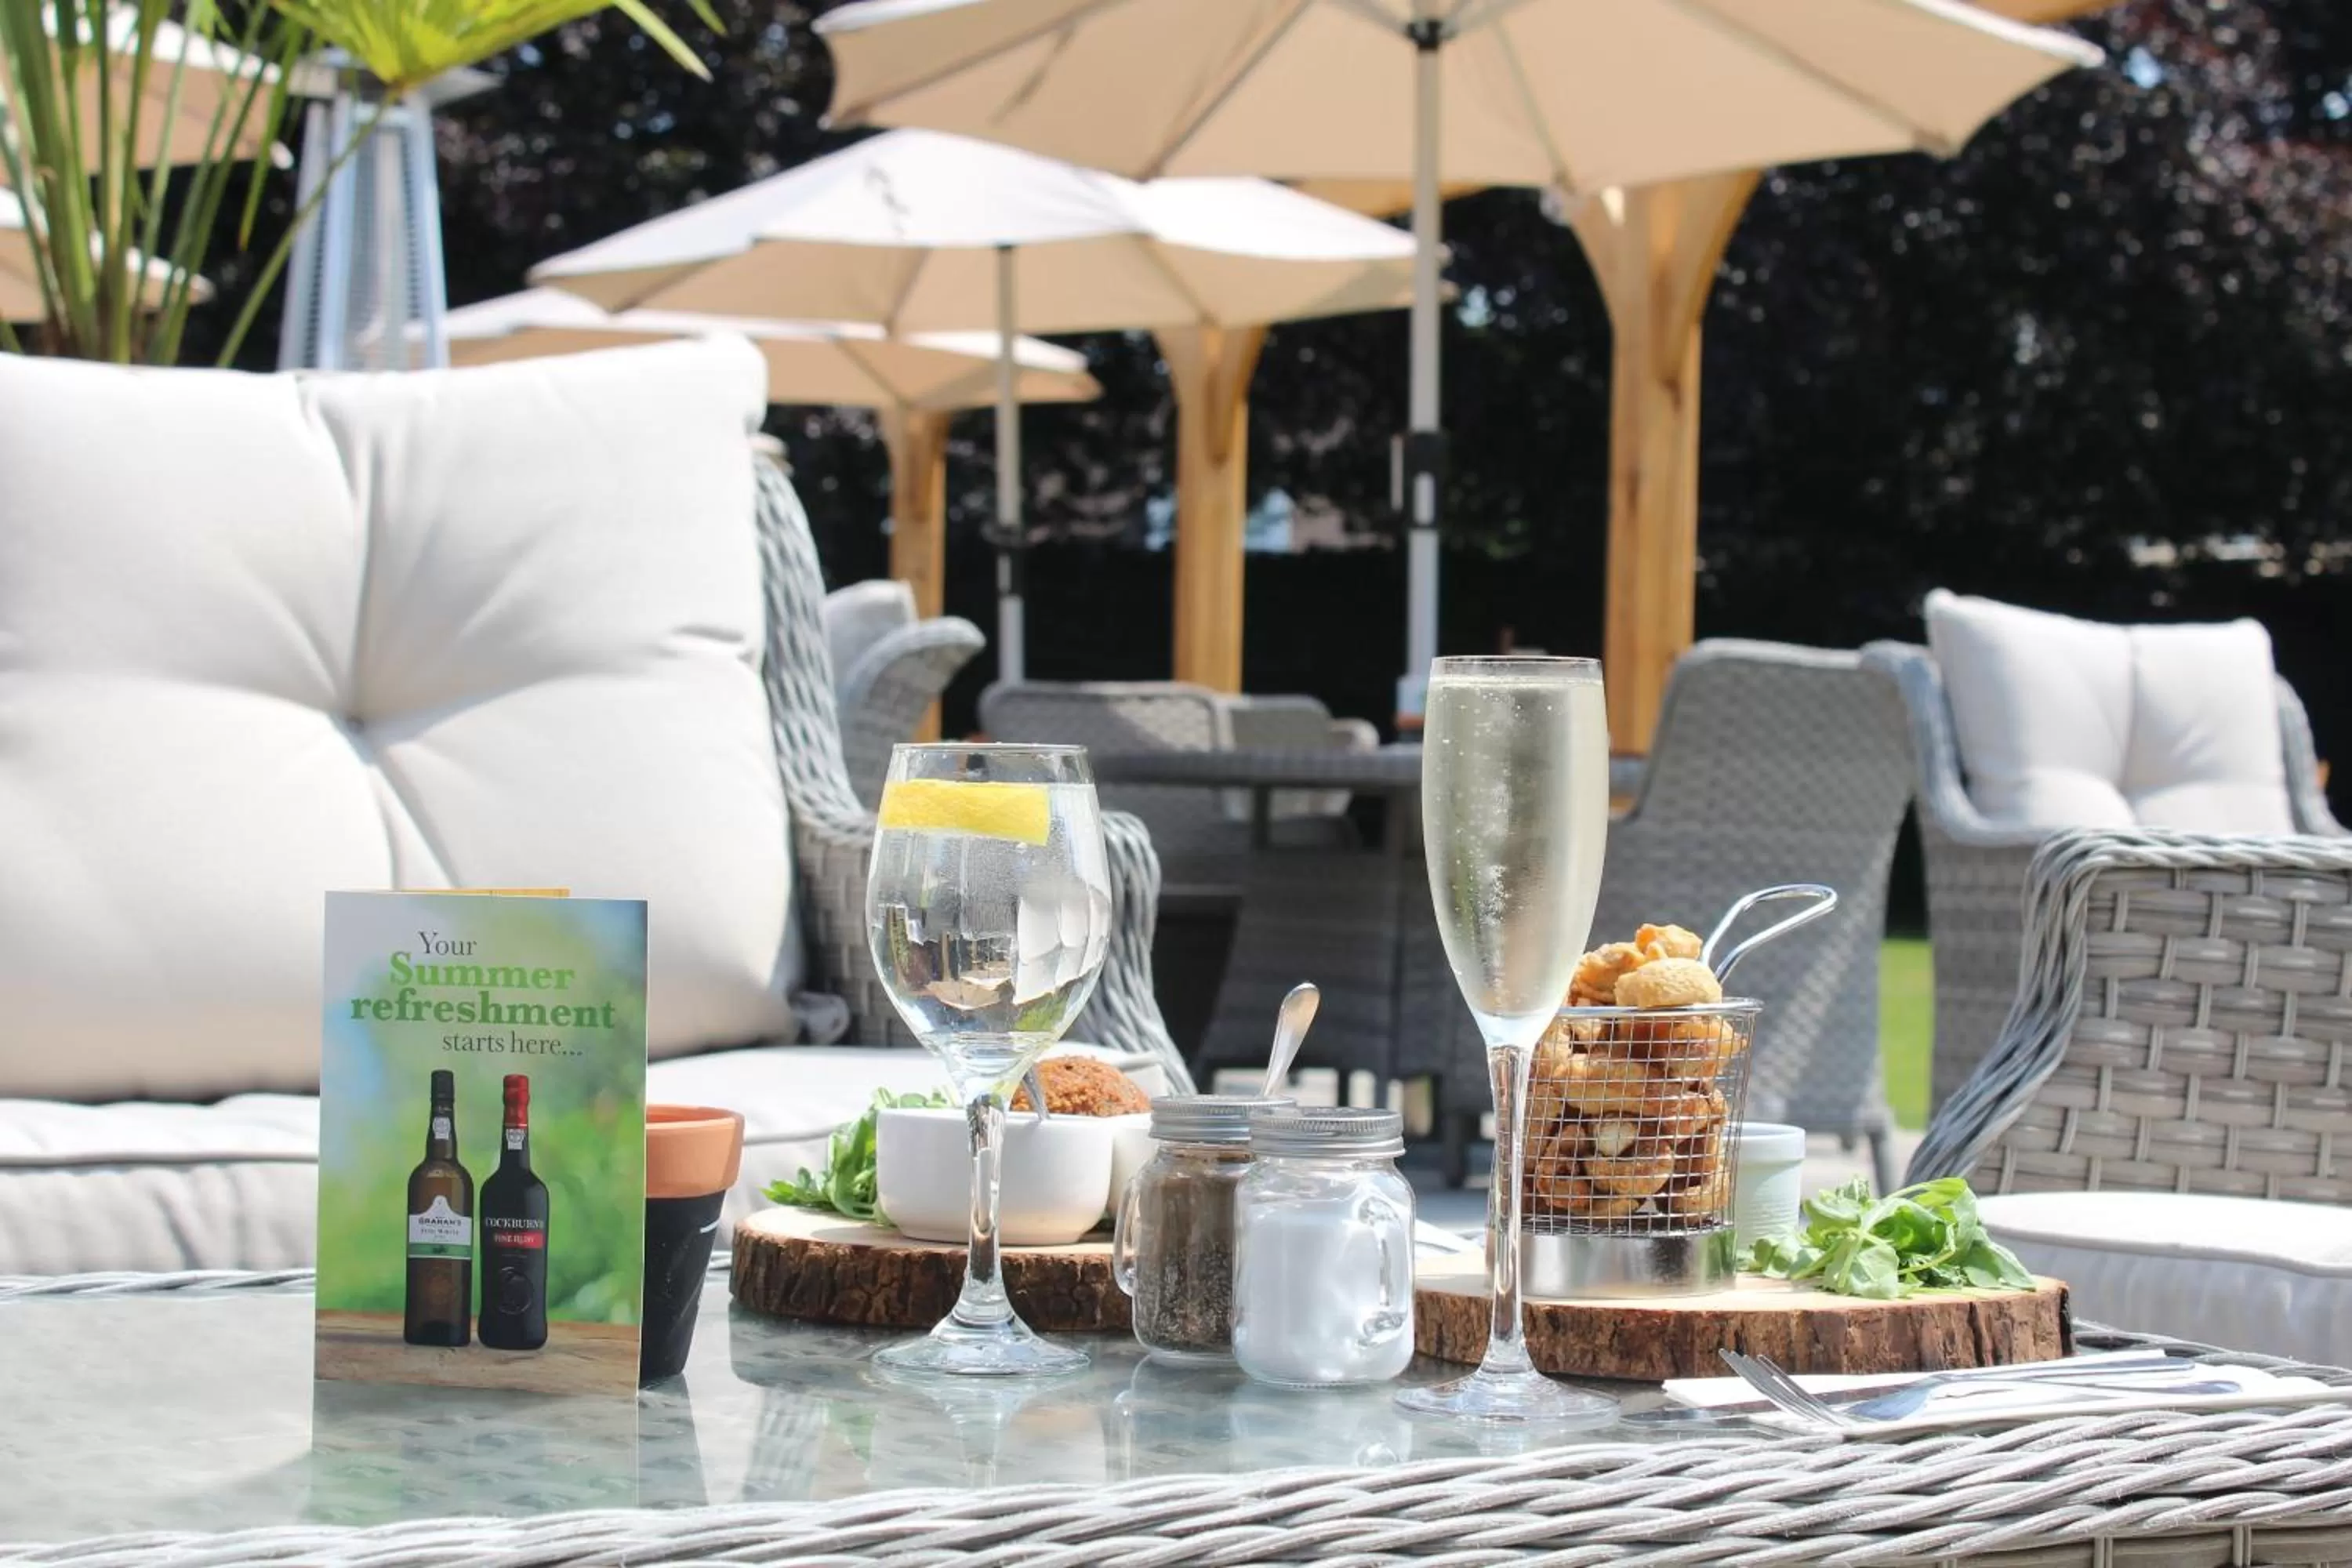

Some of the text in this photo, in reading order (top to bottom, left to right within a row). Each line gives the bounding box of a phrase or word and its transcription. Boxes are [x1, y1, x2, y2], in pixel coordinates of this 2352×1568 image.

[418, 931, 477, 956] Your
[390, 951, 575, 989] Summer
[350, 987, 615, 1029] refreshment
[442, 1030, 583, 1056] starts here...
